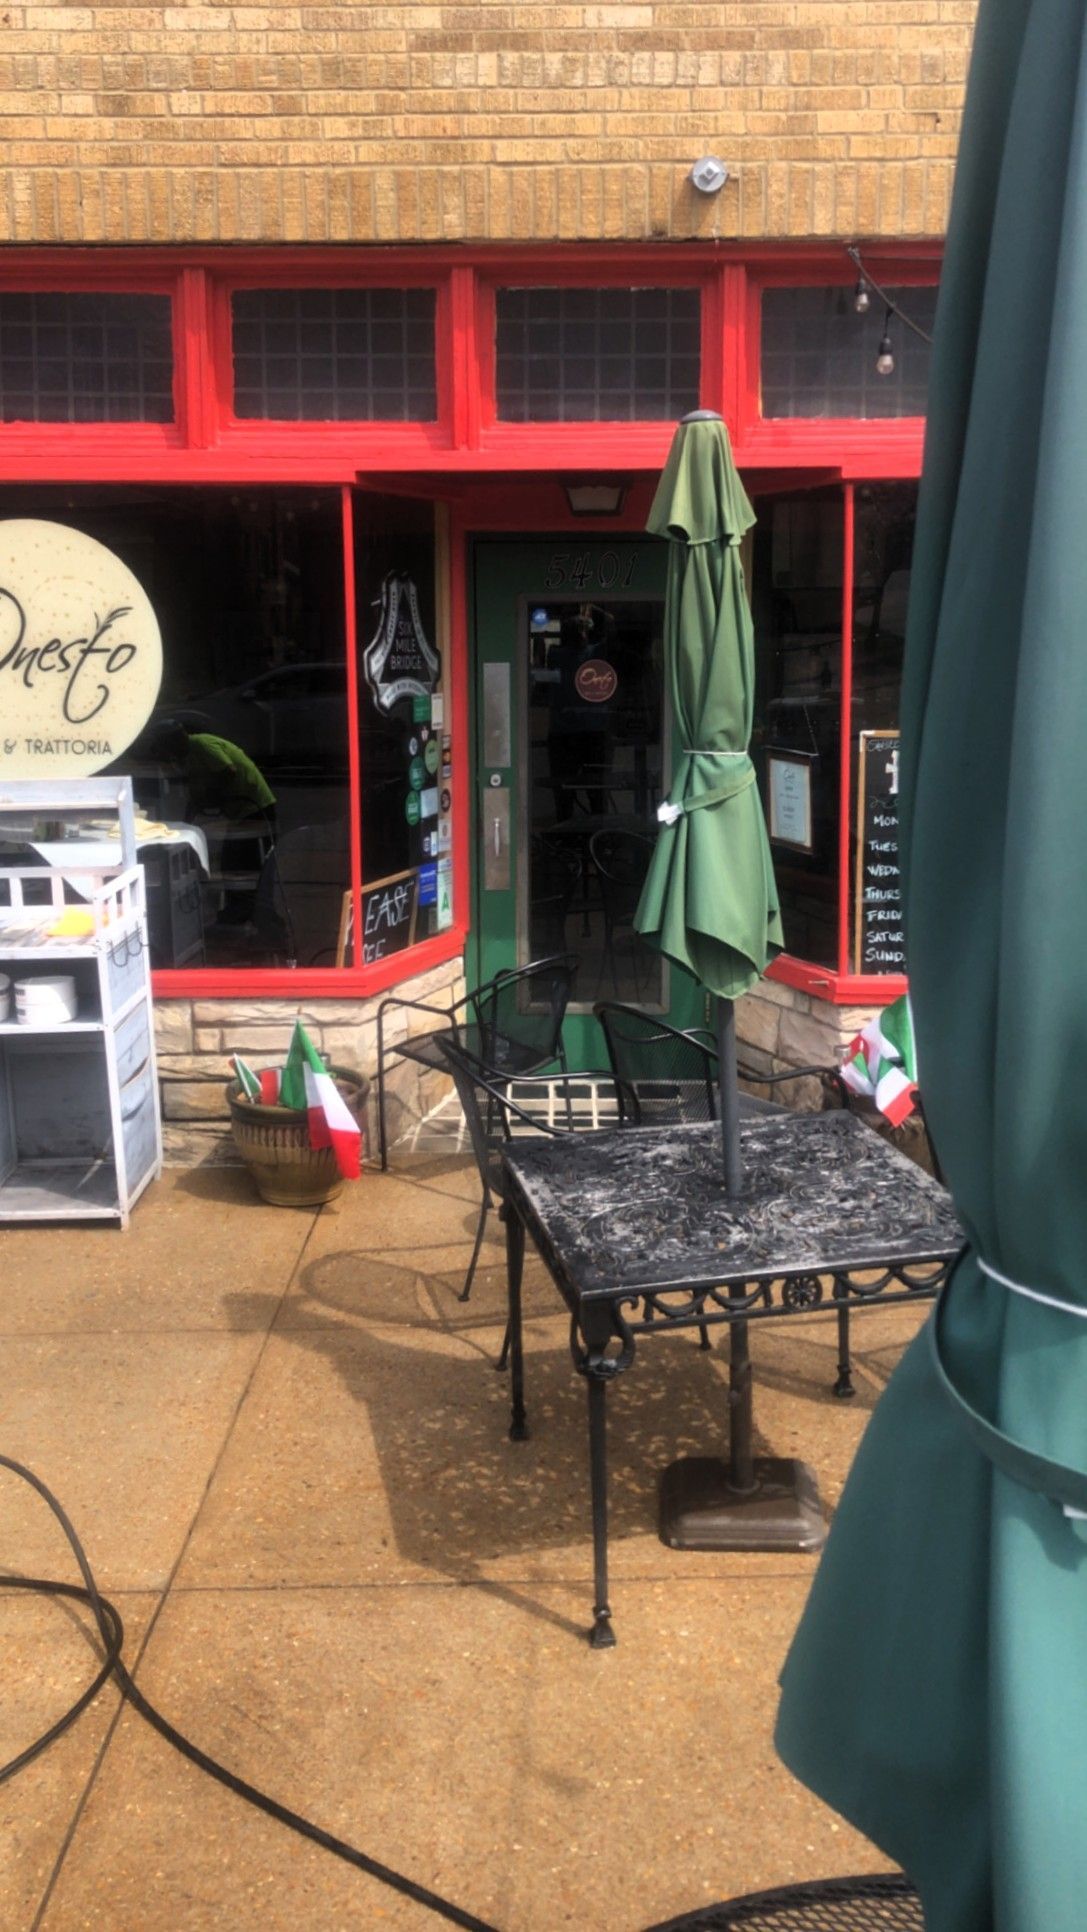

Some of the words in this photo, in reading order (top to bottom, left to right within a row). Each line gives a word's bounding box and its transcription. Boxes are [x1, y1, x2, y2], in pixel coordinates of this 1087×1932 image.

[546, 551, 639, 589] 5401
[398, 621, 413, 636] SIX
[395, 639, 416, 653] MILE
[0, 587, 137, 723] nesto
[390, 655, 423, 670] BRIDGE
[4, 738, 17, 755] &
[25, 738, 112, 755] TRATTORIA
[865, 886, 902, 900] THURS
[866, 930, 904, 944] SATUR
[865, 947, 906, 962] SUND
